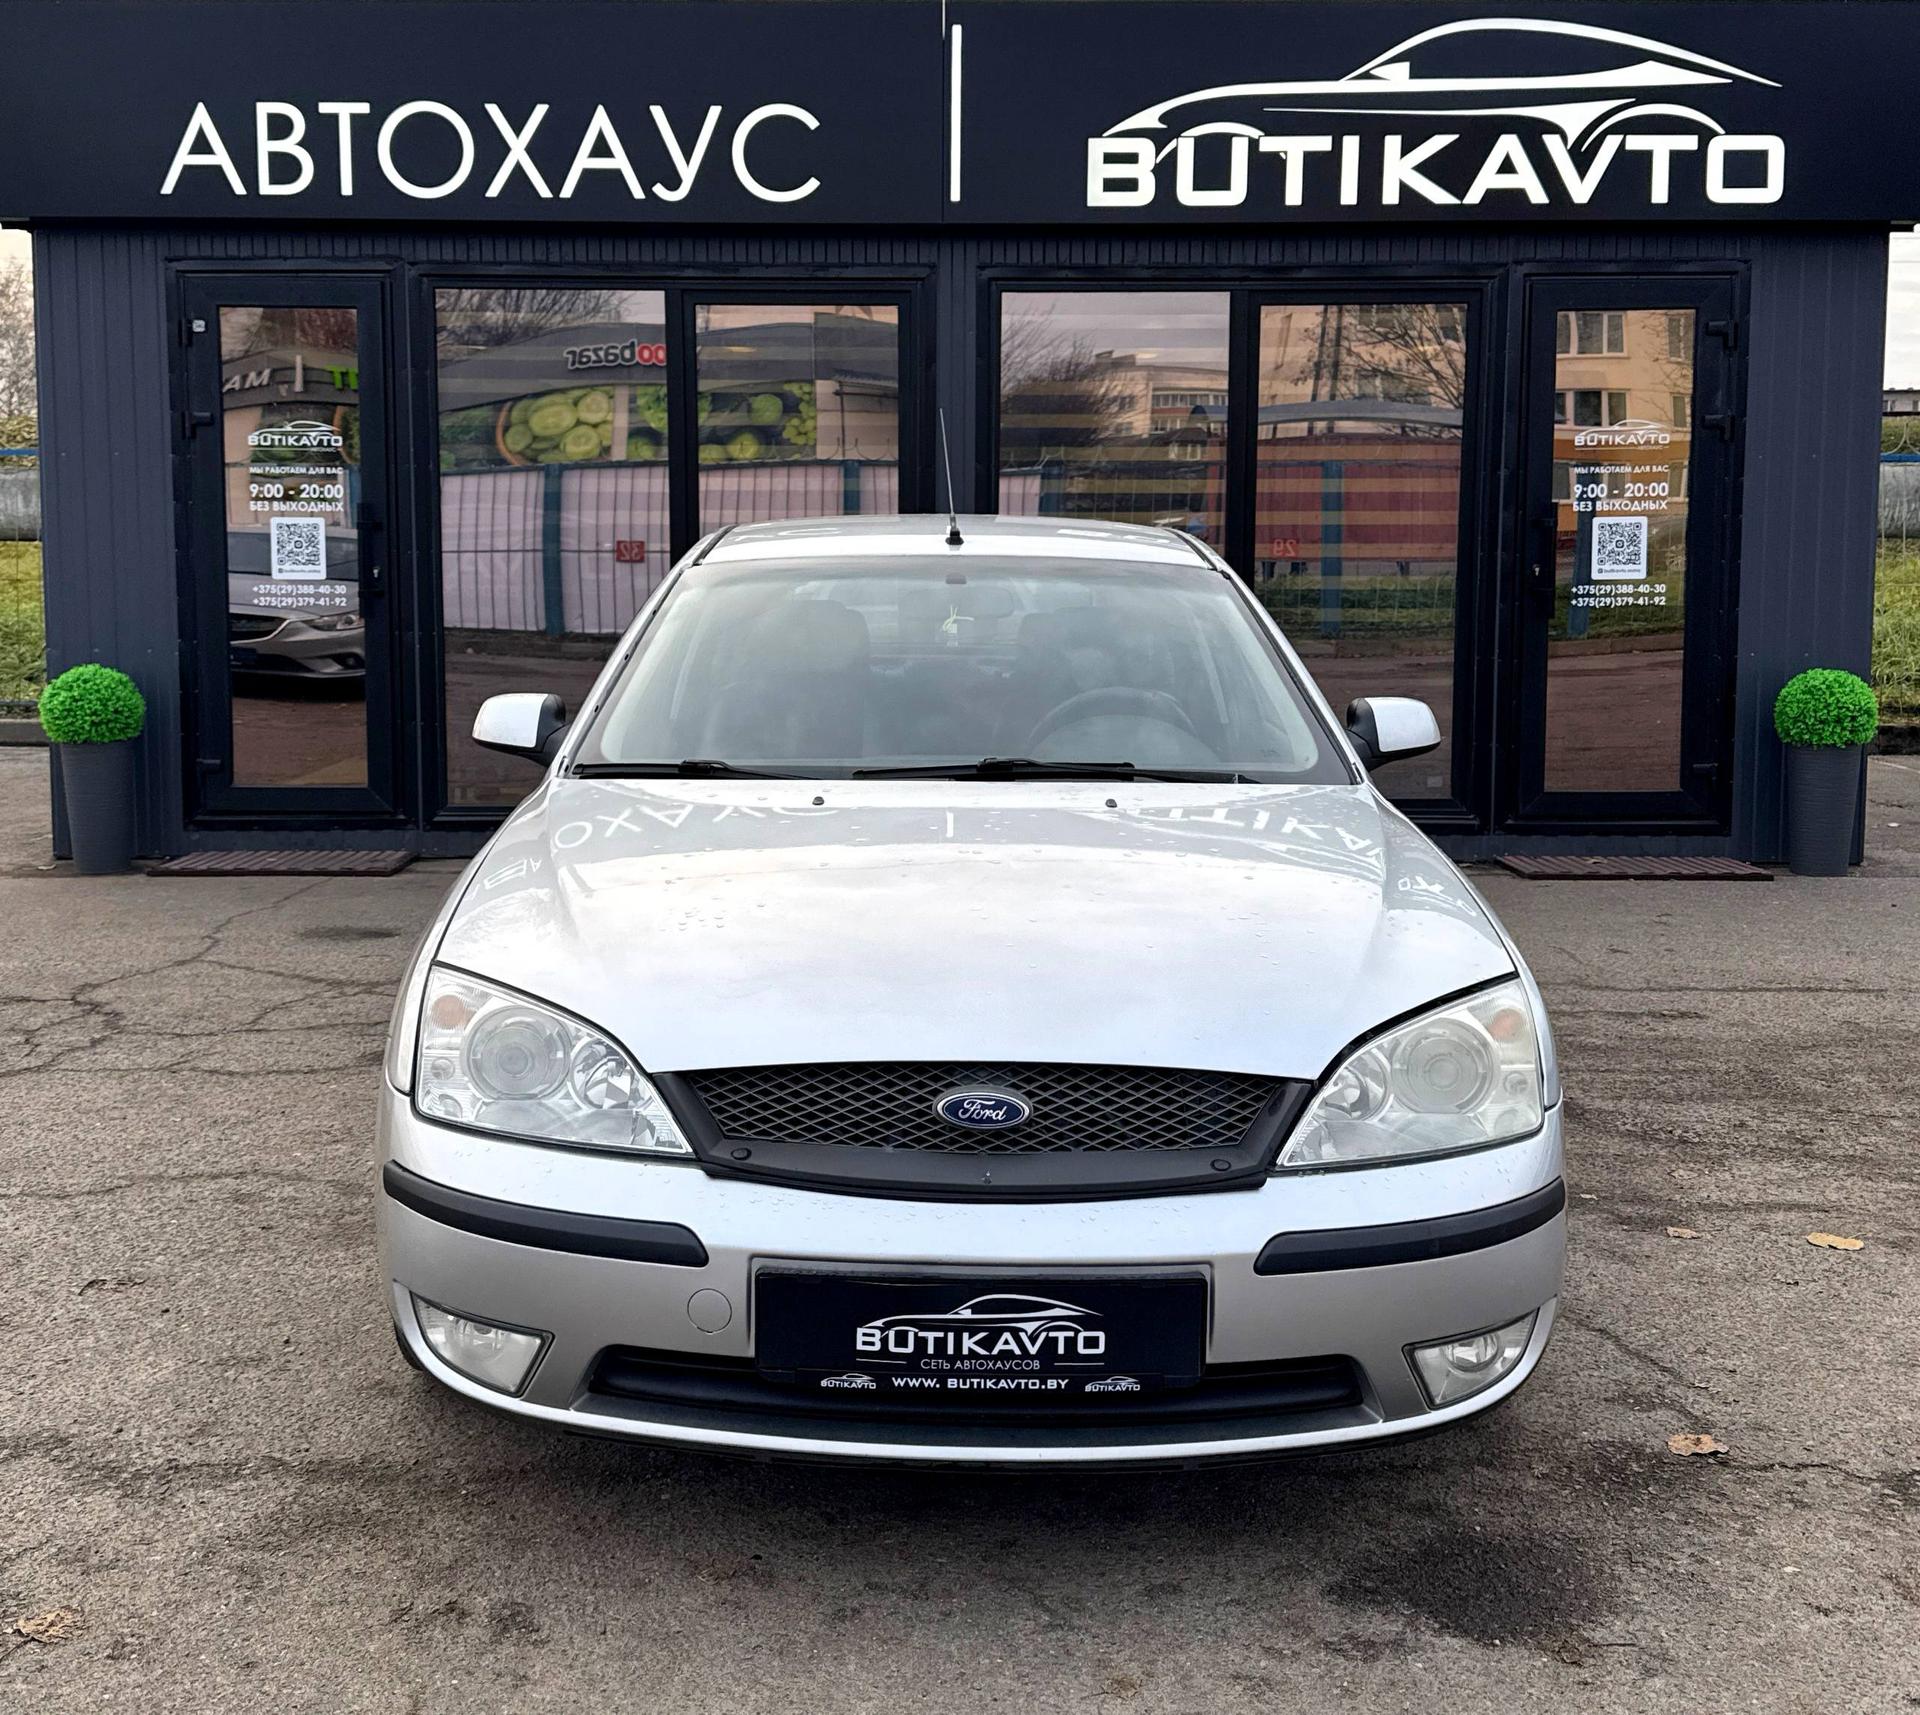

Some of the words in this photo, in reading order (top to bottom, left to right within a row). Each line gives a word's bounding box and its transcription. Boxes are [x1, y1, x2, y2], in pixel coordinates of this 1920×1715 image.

[161, 101, 820, 202] АВТОХАУС
[1087, 134, 1785, 206] BUTIKAVTO
[248, 434, 343, 447] BUTIKAVTO
[1574, 433, 1670, 446] BUTIKAVTO
[249, 466, 263, 474] МЫ
[265, 466, 307, 474] РАБОТАЕМ
[308, 466, 325, 475] ДЛЯ
[326, 466, 344, 474] ВАС
[1575, 466, 1588, 474] МЫ
[1590, 465, 1632, 474] РАБОТАЕМ
[1633, 465, 1651, 473] ДЛЯ
[1652, 464, 1669, 473] ВАС
[249, 483, 284, 498] 9:00
[300, 483, 344, 498] 20:00
[1574, 483, 1607, 498] 9:00
[1624, 482, 1669, 497] 20:00
[249, 501, 270, 511] БЕЗ
[272, 501, 344, 512] ВЫХОДНЫХ
[1572, 501, 1593, 512] БЕЗ
[1596, 500, 1668, 511] ВЫХОДНЫХ
[252, 585, 347, 596] +375(29)388-40-30
[1571, 584, 1666, 596] +375(29)388-40-30
[252, 597, 347, 608] +375(29)379-41-92
[1571, 597, 1666, 608] +375(29)379-41-92
[958, 1098, 1007, 1121] Ford
[856, 1327, 1106, 1355] BUTIKAVTO
[920, 1358, 951, 1370] СЕТЬ
[954, 1359, 1041, 1371] АВТОХАУСОВ
[820, 1380, 877, 1390] BUTIKAVTO
[892, 1376, 940, 1389] WWW.
[947, 1378, 1069, 1390] BUTIKAVTO.BY
[1085, 1384, 1141, 1392] BUTIKAVTO
